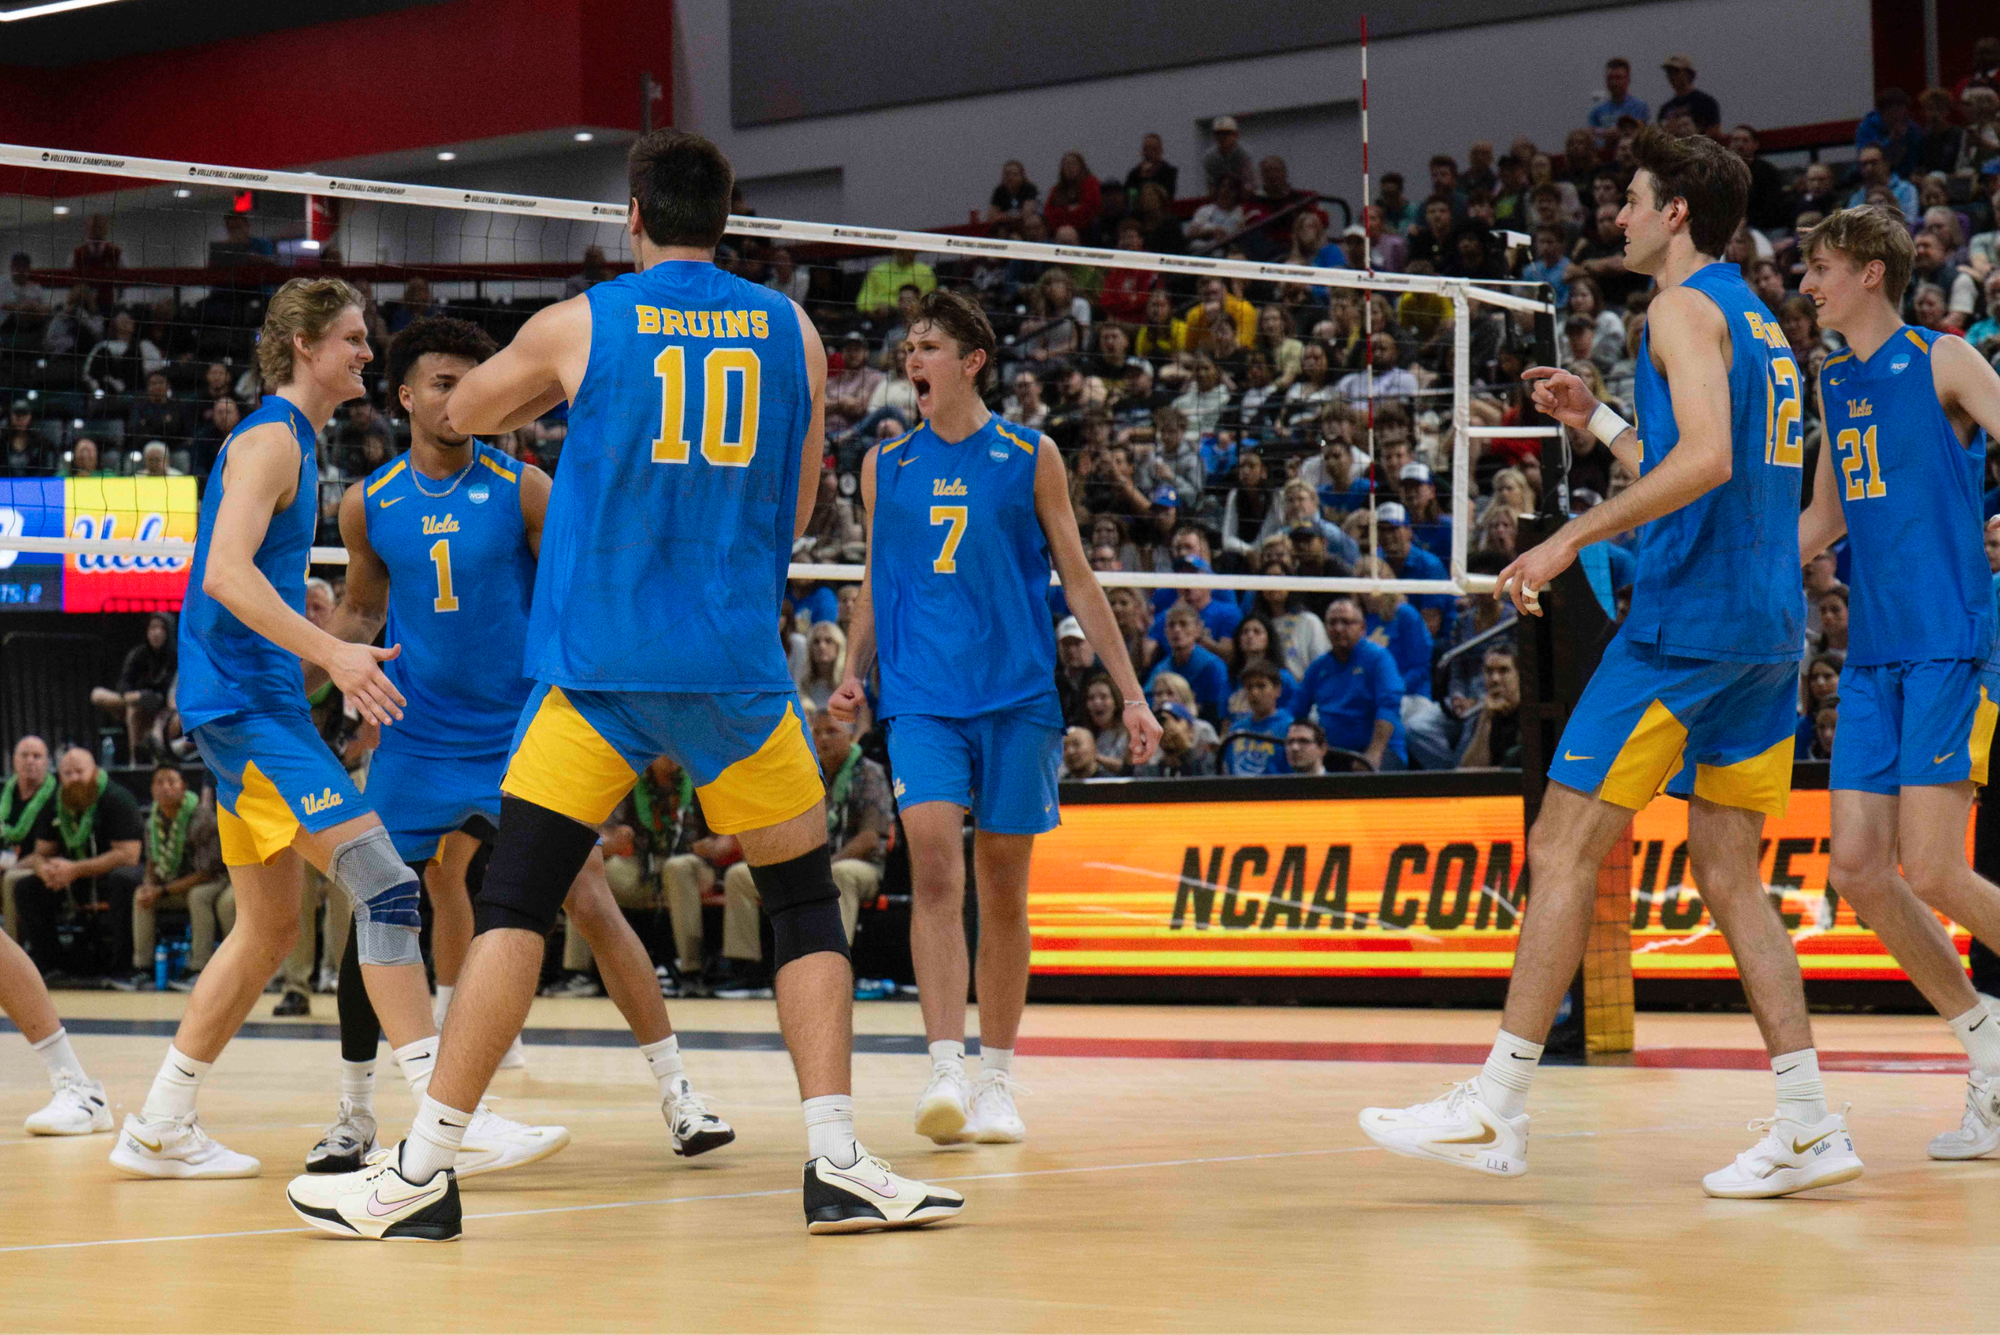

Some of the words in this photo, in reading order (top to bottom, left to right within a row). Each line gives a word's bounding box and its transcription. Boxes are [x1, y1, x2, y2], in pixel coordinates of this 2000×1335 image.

[50, 153, 83, 165] VOLLEYBALL
[82, 157, 126, 168] CHAMPIONSHIP
[197, 168, 228, 179] VOLLEYBALL
[228, 171, 269, 182] CHAMPIONSHIP
[336, 182, 367, 192] VOLLEYBALL
[366, 185, 406, 195] CHAMPIONSHIP
[635, 304, 770, 340] BRUINS
[651, 345, 761, 468] 10
[1847, 397, 1873, 418] Ucla
[1837, 424, 1887, 501] 21
[932, 477, 968, 496] Ucla
[421, 513, 460, 535] Ucla
[930, 506, 968, 574] 7
[429, 538, 460, 613] 1
[300, 787, 344, 816] Ucla
[1812, 1140, 1832, 1156] Ucla
[1486, 1158, 1509, 1173] LLB
